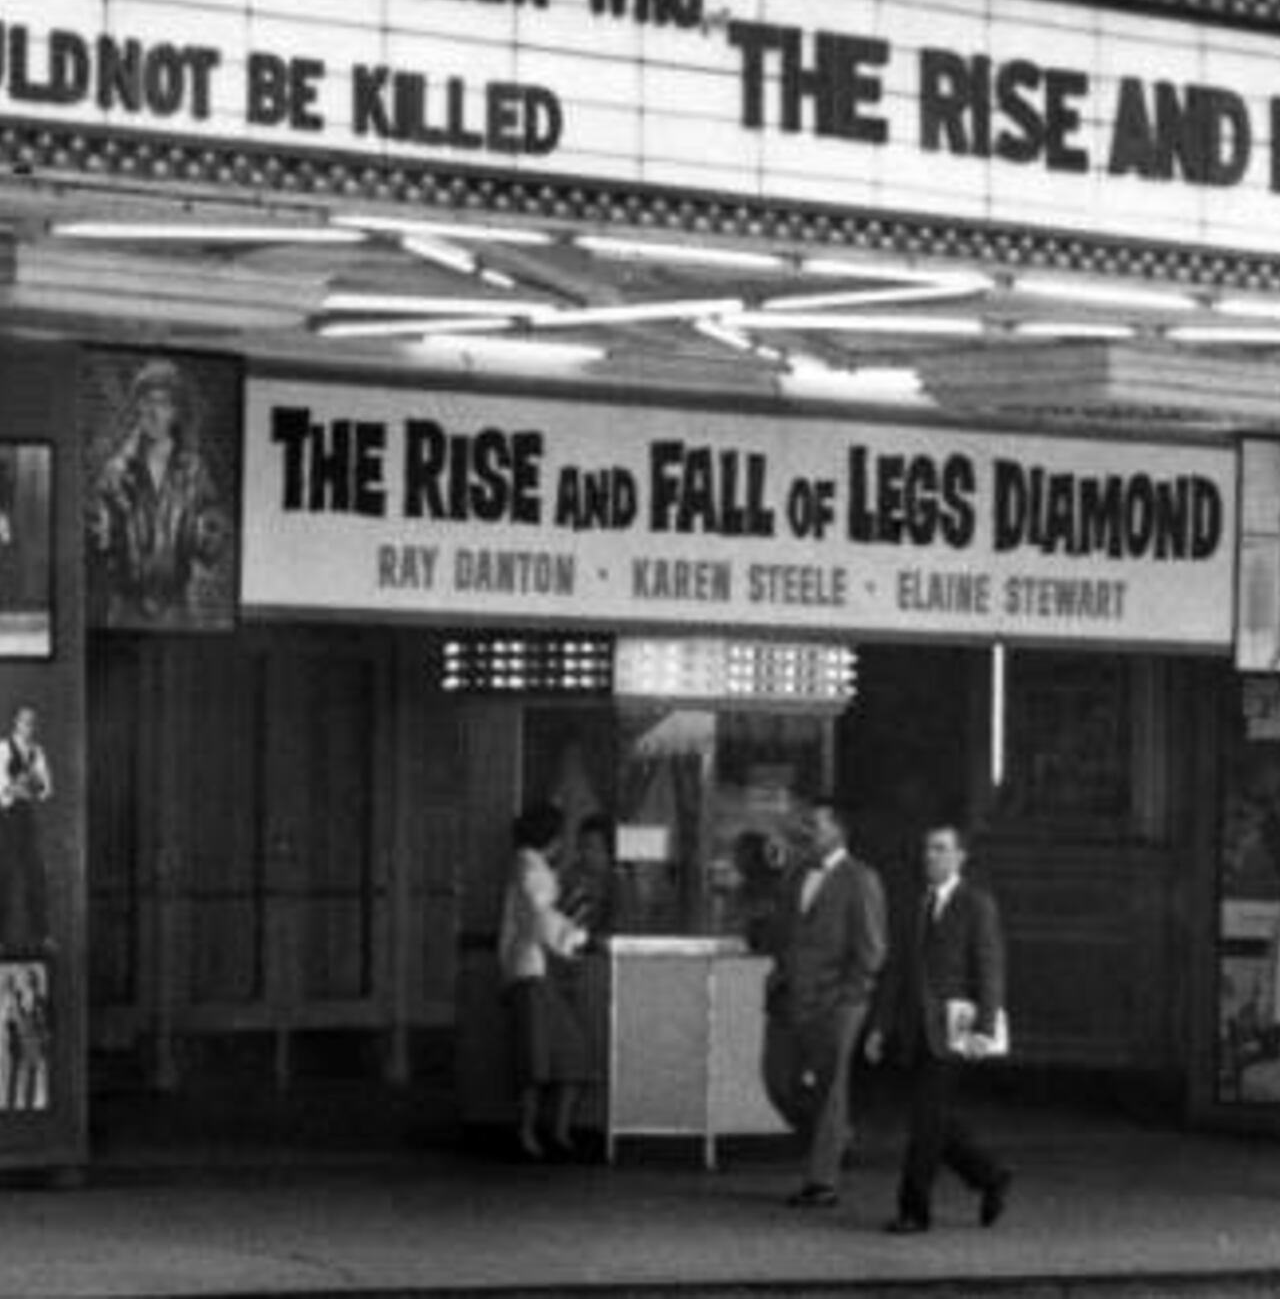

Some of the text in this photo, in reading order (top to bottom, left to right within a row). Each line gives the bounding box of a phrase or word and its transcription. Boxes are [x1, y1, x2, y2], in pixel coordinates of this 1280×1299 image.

[246, 52, 324, 131] BE
[351, 64, 564, 156] KILLED
[919, 45, 1090, 175] RISE
[1108, 73, 1252, 189] AND
[270, 405, 1223, 562] THE RISE AND FALL OF LEGS DIAMOND
[377, 543, 1128, 620] RAY DANTON KAREN STEELE ELAINE STEWART
